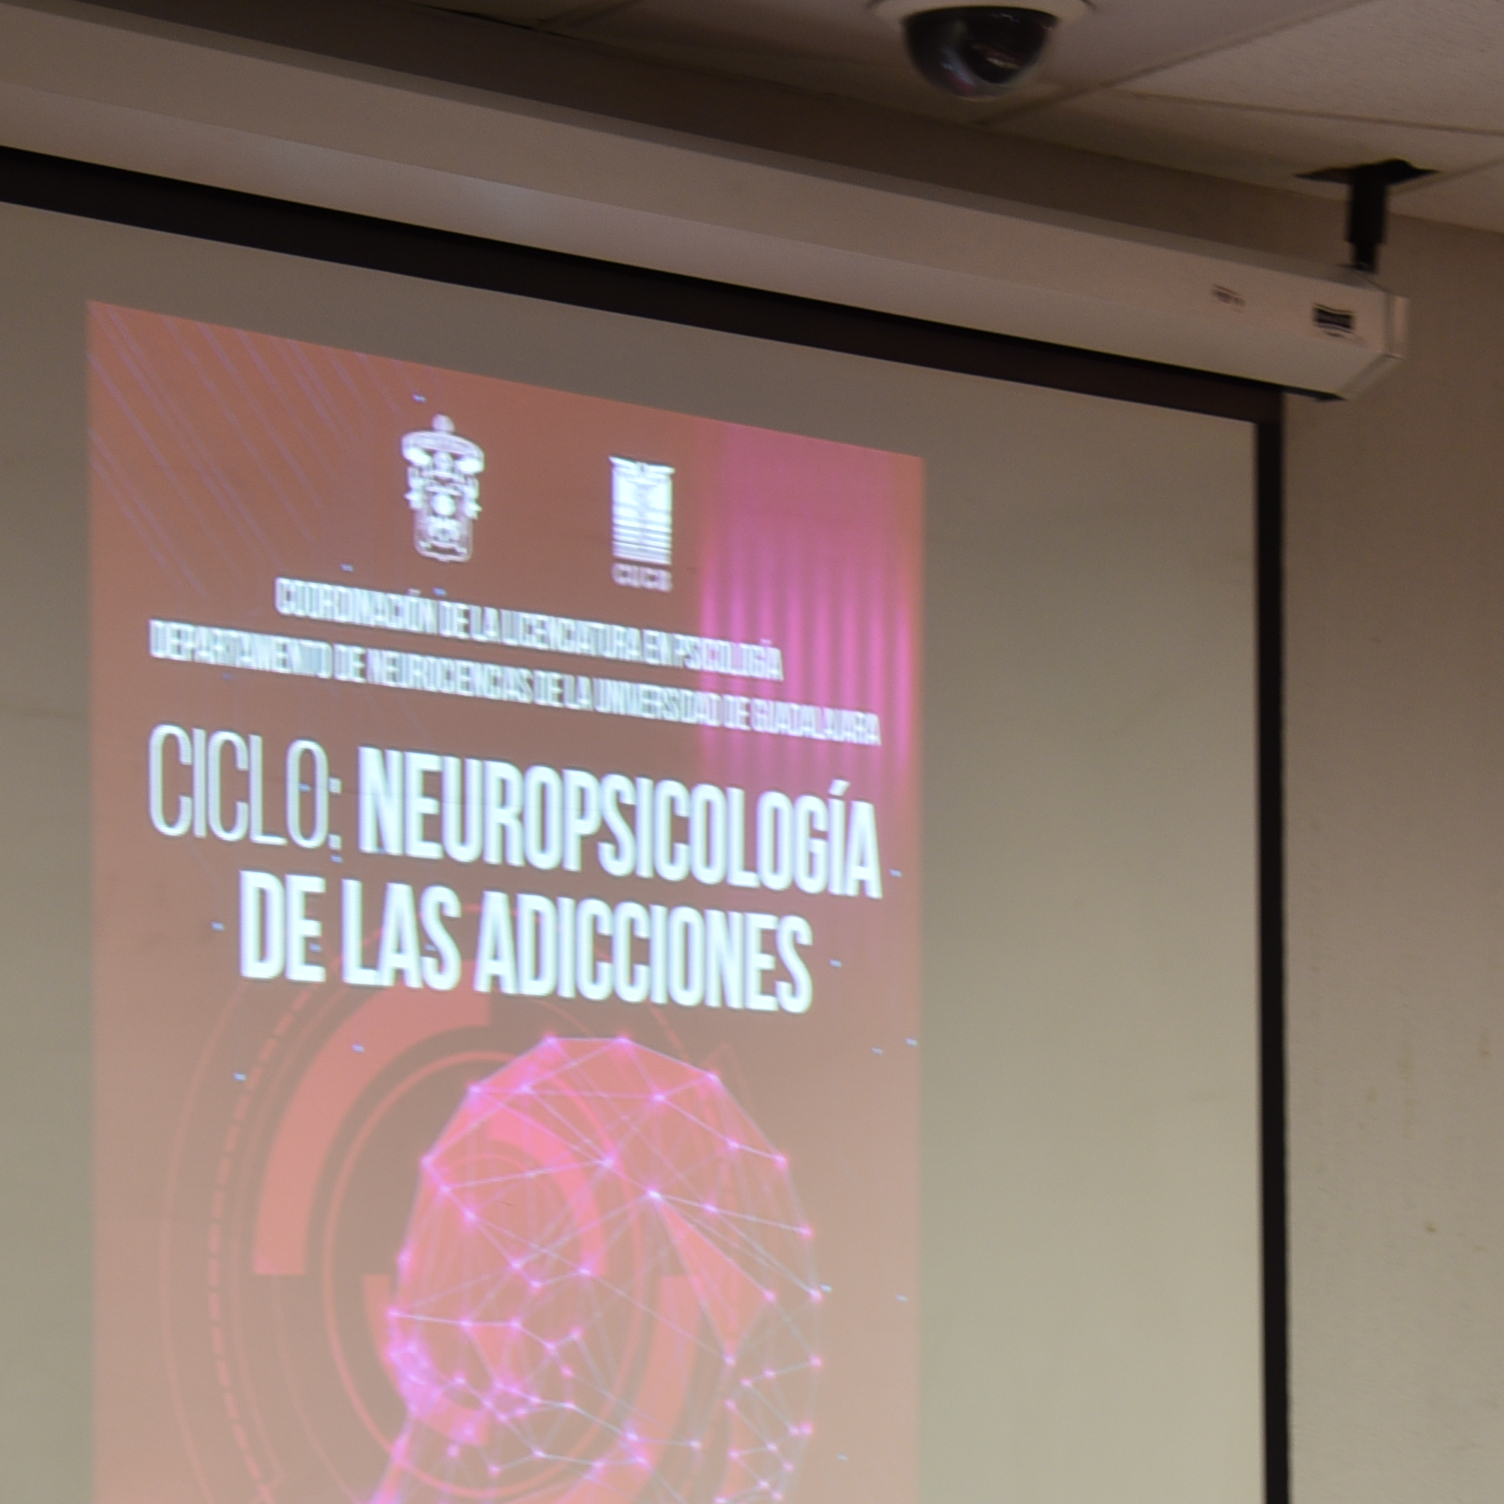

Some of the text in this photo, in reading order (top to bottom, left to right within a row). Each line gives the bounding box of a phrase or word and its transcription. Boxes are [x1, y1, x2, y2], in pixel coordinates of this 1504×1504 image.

[149, 618, 333, 679] DEPARTAMENTO
[333, 643, 367, 684] DE
[534, 669, 563, 708] DE
[563, 673, 594, 711] LA
[594, 677, 722, 728] UNIVERSIDAD
[722, 693, 752, 732] DE
[752, 697, 882, 746] GUADALAJARA
[275, 577, 785, 682] COORDINACIÓN DE LA LICENCIATURA EN PSICOLOGÍA
[148, 722, 883, 899] CICLO: NEUROPSICOLOGÍA
[239, 869, 815, 1013] DE LAS ADICCIONES
